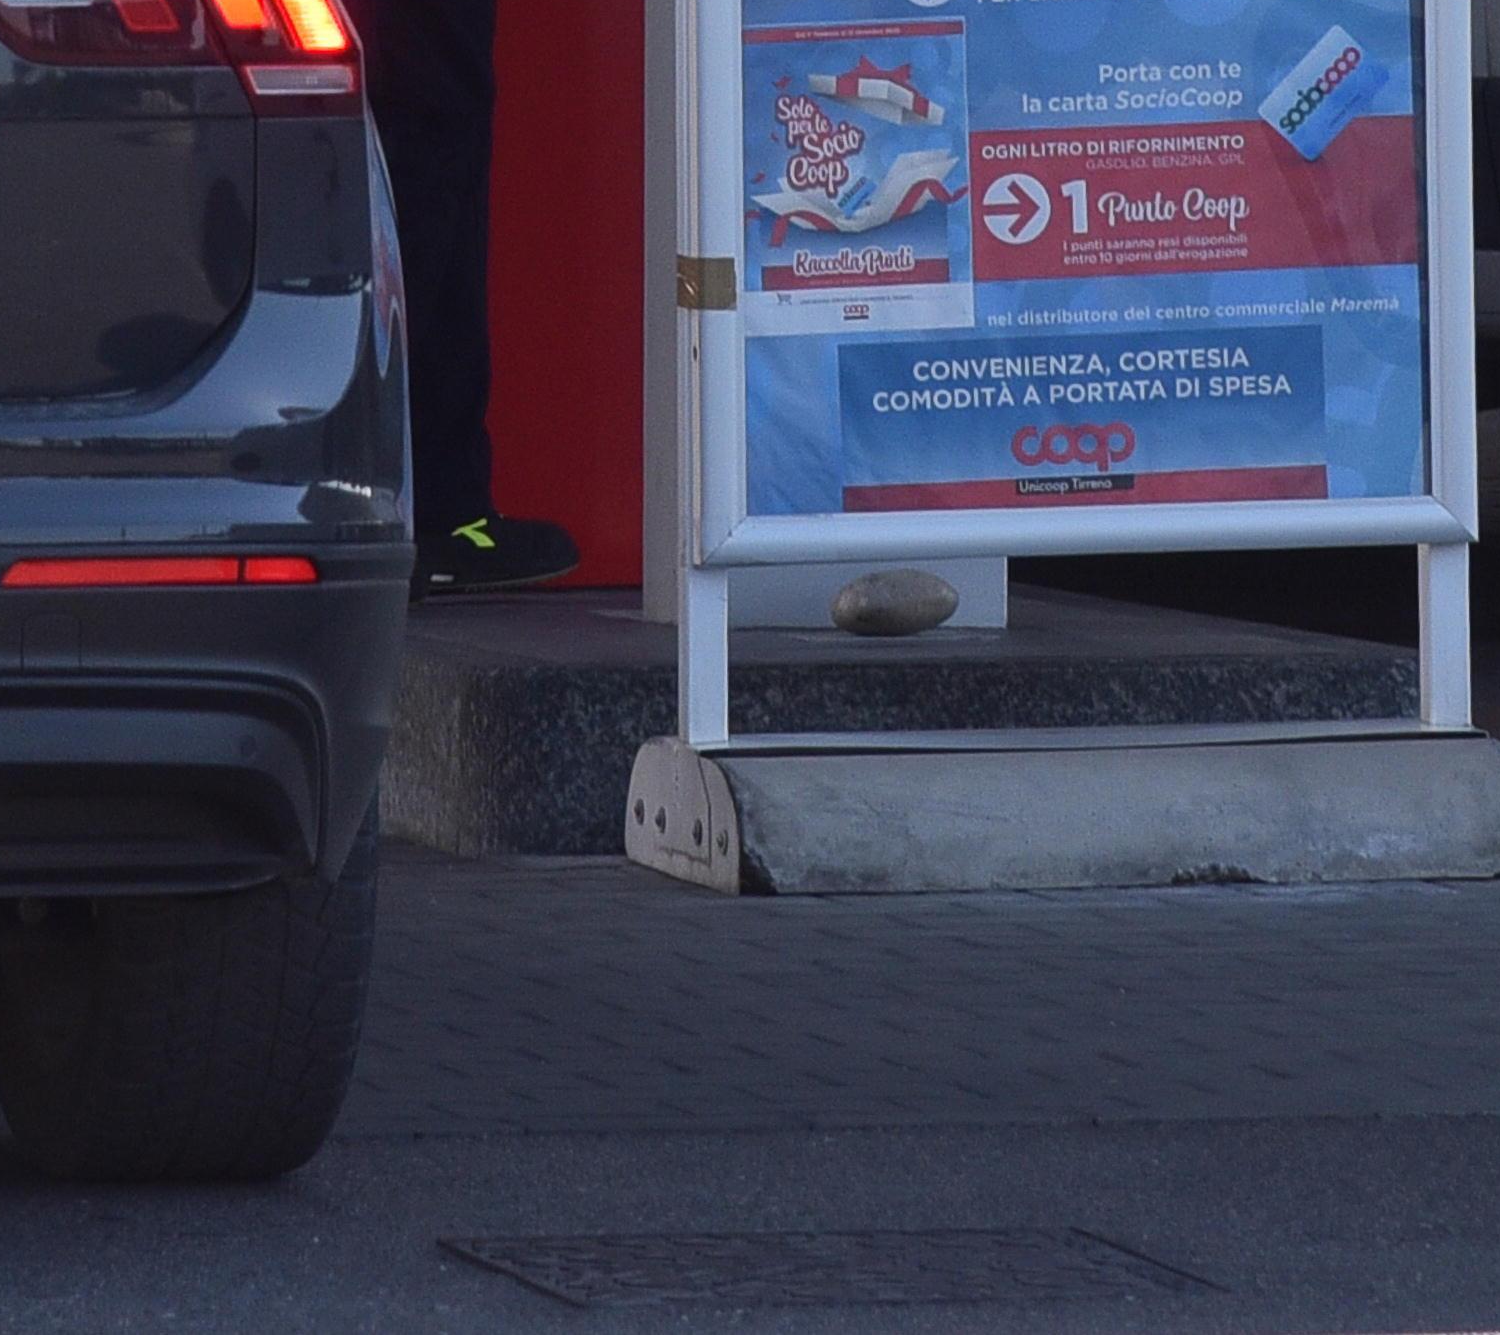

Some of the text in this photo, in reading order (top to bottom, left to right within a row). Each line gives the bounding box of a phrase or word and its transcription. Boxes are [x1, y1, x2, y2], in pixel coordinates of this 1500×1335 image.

[1100, 60, 1242, 84] Porta con te
[1022, 87, 1243, 113] la carta SocioCoop
[1279, 47, 1361, 134] sociocoop
[777, 96, 815, 119] Solo
[803, 125, 860, 163] Socio
[982, 135, 1244, 160] OGNI LITRO DI RIFORNIMENTO
[1219, 153, 1245, 165] GPL
[789, 157, 846, 194] Coop
[1061, 180, 1250, 234] 1 Punto Coop
[1071, 238, 1104, 253] punti
[1106, 237, 1155, 250] saranno
[1158, 235, 1180, 248] resi
[1183, 233, 1248, 249] disponibili
[1063, 252, 1097, 265] entro
[1099, 251, 1113, 264] 10
[1116, 249, 1151, 265] giorni
[987, 311, 1013, 327] nel
[1018, 305, 1118, 326] distributore
[1124, 306, 1150, 321] del
[1155, 304, 1210, 320] centro
[1215, 300, 1325, 318] commerciale
[913, 347, 1250, 381] CONVENIENZA, CORTESIA
[872, 375, 1292, 413] COMODITÀ A PORTATA DI SPESA
[1011, 421, 1136, 472] coop
[1019, 477, 1112, 496] Unicoop Tirreno
